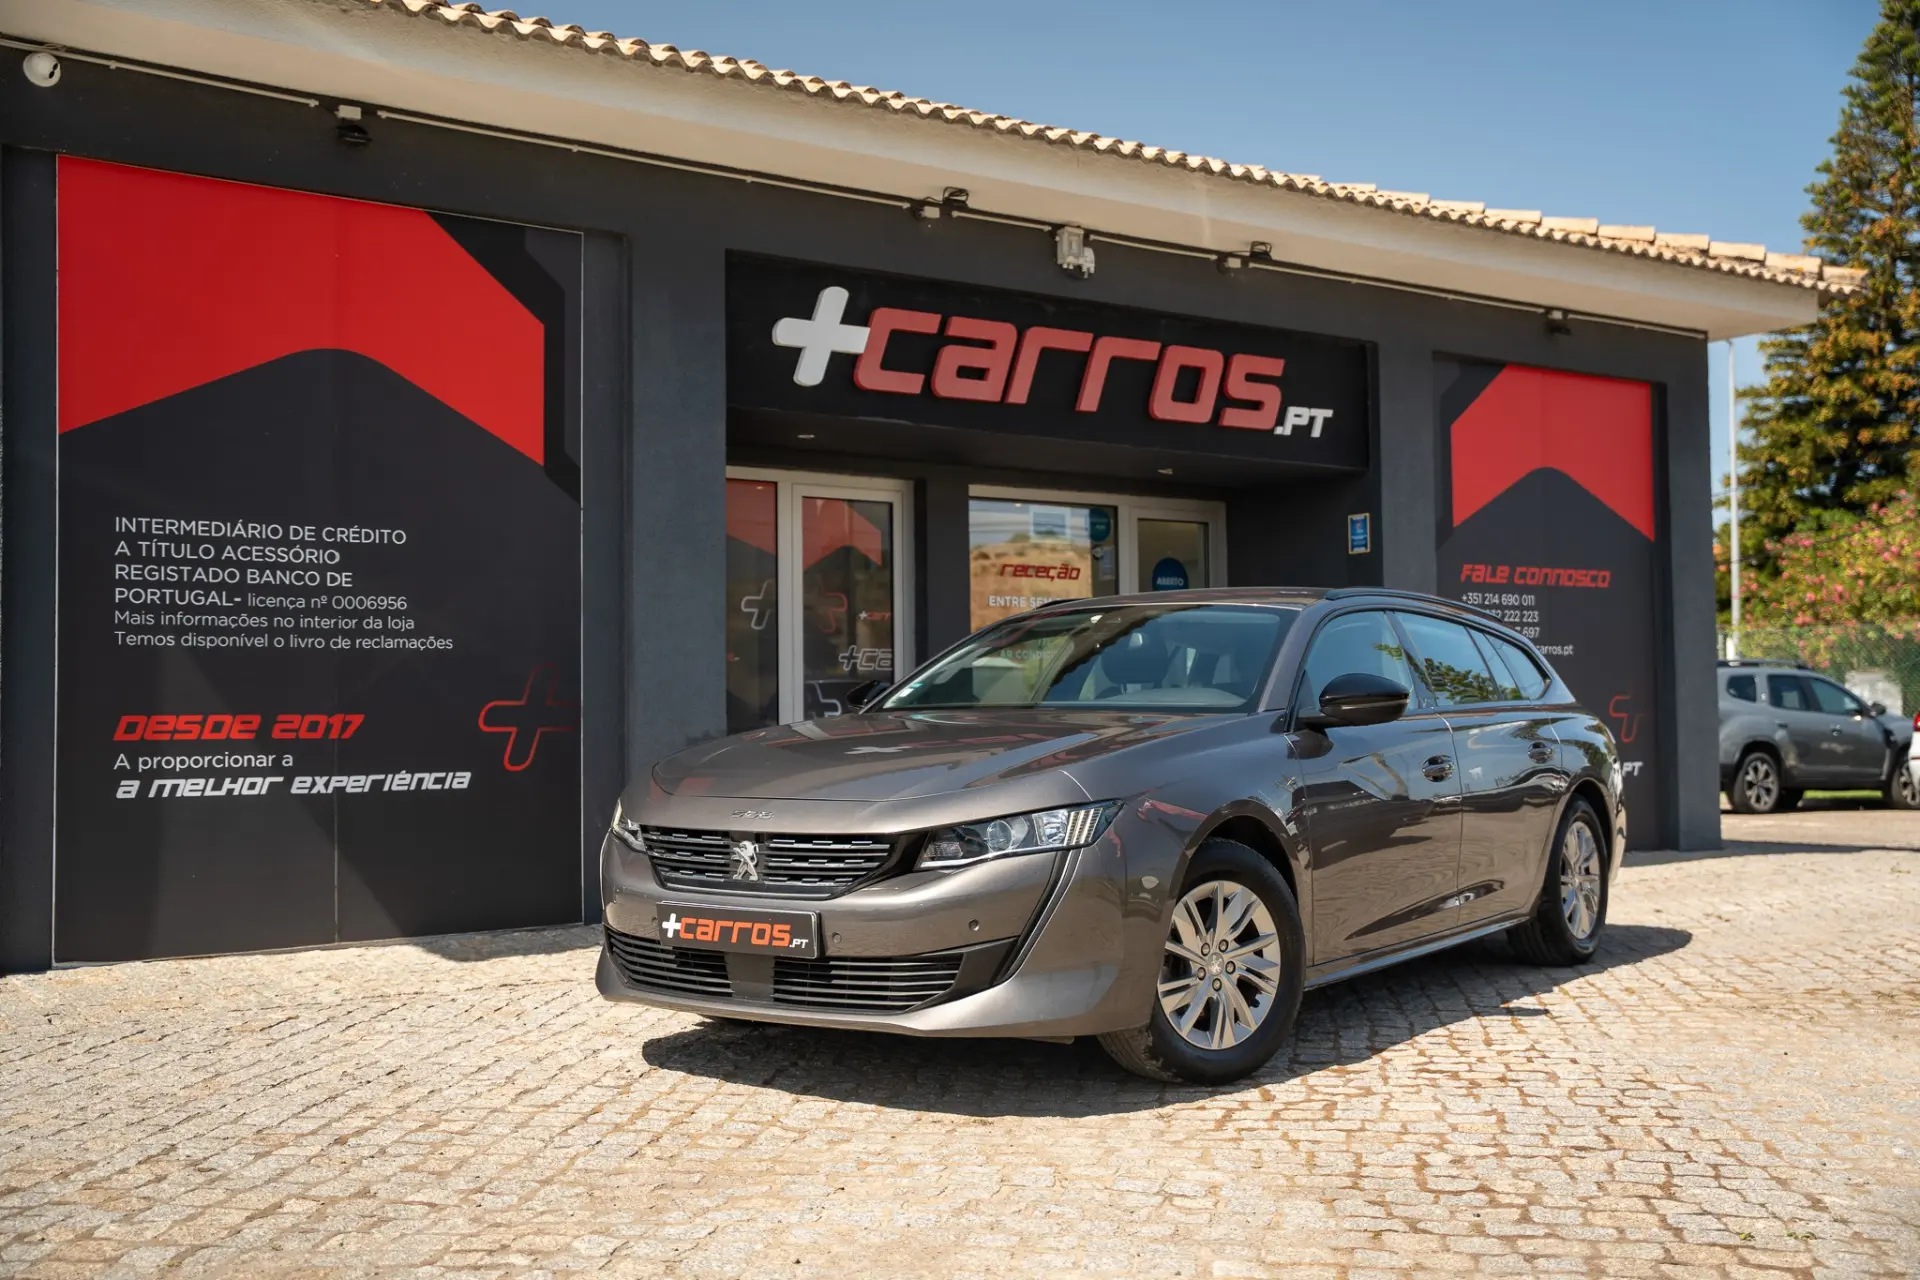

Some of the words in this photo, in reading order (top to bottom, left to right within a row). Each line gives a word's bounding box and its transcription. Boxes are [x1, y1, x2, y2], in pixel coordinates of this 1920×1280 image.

[115, 516, 283, 540] INTERMEDIÁRIO
[289, 525, 316, 541] DE
[322, 525, 407, 545] CRÉDITO
[114, 540, 131, 556] A
[137, 539, 215, 560] TÍTULO
[221, 545, 340, 564] ACESSÓRIO
[115, 564, 240, 584] REGISTADO
[247, 569, 320, 586] BANCO
[326, 572, 353, 587] DE
[1000, 563, 1081, 582] receção
[115, 587, 242, 606] PORTUGAL-
[247, 592, 305, 610] licença
[331, 595, 408, 610] 0006956
[988, 595, 1027, 608] ENTRE
[1461, 592, 1482, 605] +351
[1484, 593, 1500, 605] 214
[1501, 594, 1520, 606] 690
[1521, 594, 1536, 606] 011
[114, 610, 155, 626] Mais
[160, 611, 269, 628] informações
[273, 616, 295, 628] no
[299, 614, 359, 629] interior
[362, 615, 383, 630] da
[387, 615, 415, 632] loja
[1503, 610, 1521, 622] 222
[1522, 610, 1539, 623] 223
[113, 631, 176, 647] Temos
[180, 632, 269, 649] disponível
[273, 636, 285, 648] o
[289, 634, 326, 649] livro
[329, 635, 352, 649] de
[355, 635, 453, 651] reclamações
[1522, 626, 1541, 639] 697
[271, 713, 365, 740] 2017
[113, 753, 131, 770] A
[138, 751, 276, 773] proporcionar
[281, 754, 294, 767] a
[115, 779, 141, 799] a
